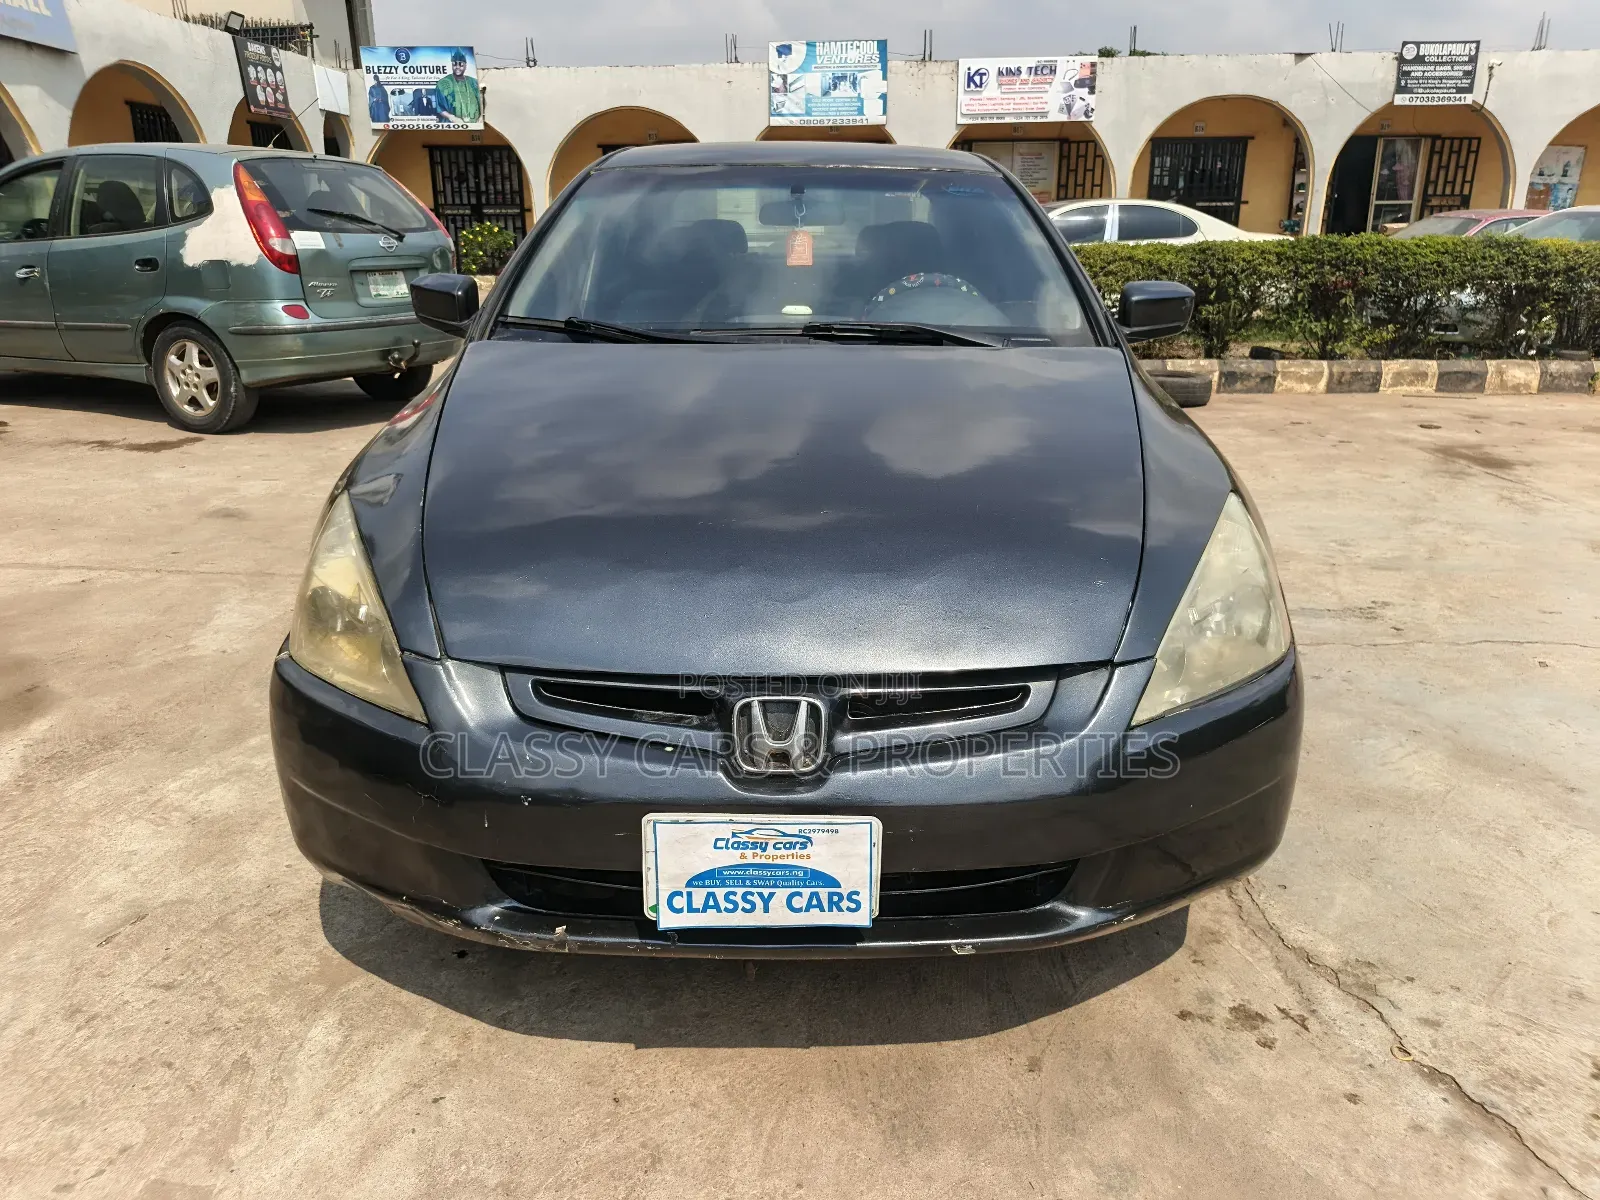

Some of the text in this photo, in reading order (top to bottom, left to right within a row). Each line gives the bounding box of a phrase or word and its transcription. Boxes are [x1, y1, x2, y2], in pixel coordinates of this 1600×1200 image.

[1419, 43, 1476, 55] BUKOLAPAULA'S
[816, 54, 880, 64] VENTURES
[365, 65, 448, 75] BLEZZY COUTURE
[998, 65, 1058, 77] KINS TECH
[713, 837, 809, 852] Classy cars
[752, 852, 812, 862] Properties
[722, 869, 804, 878] www.classycars.ng
[666, 890, 862, 914] CLASSY CARS
